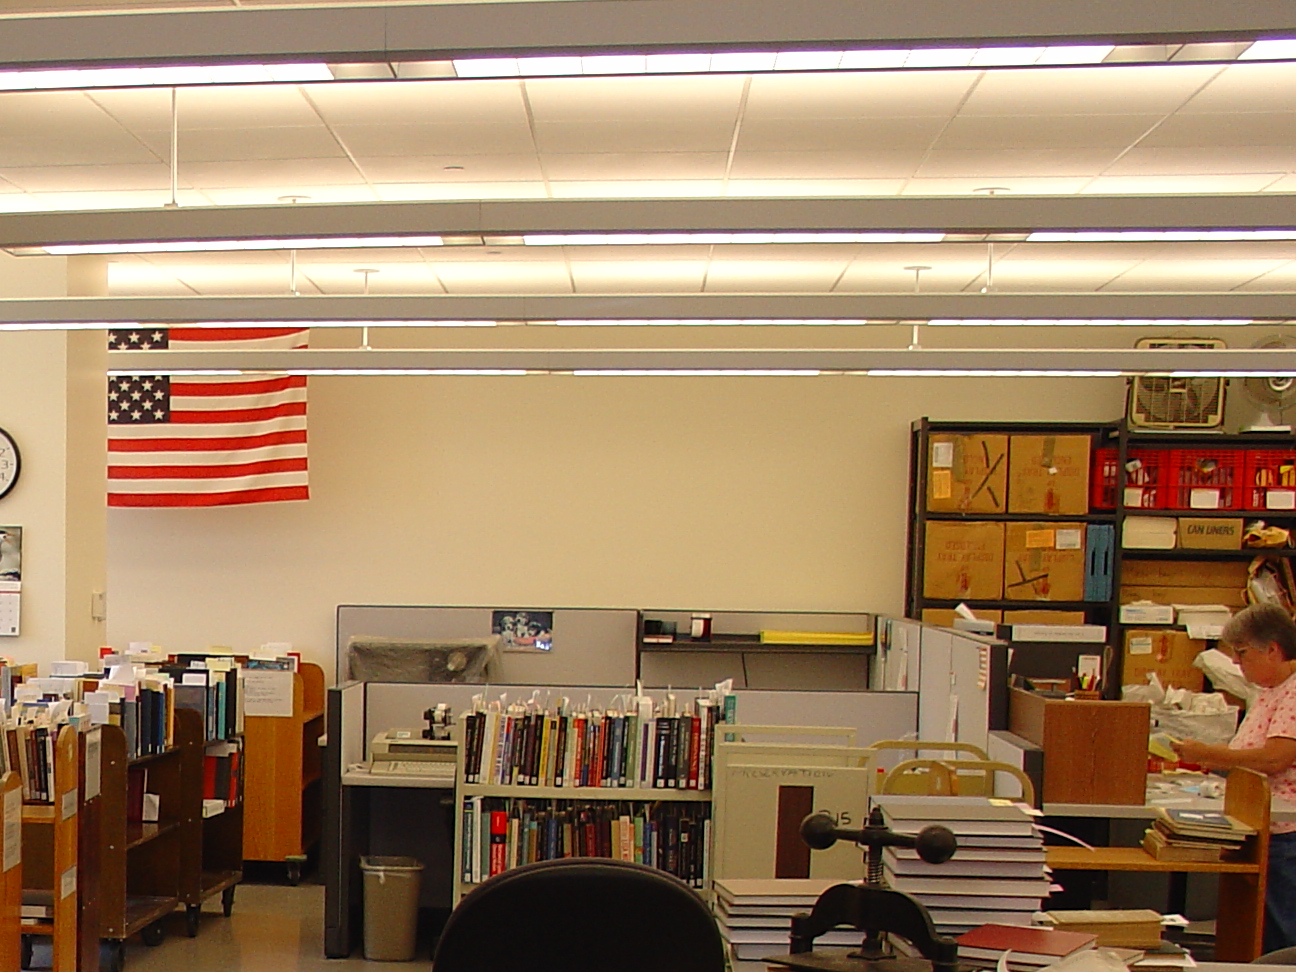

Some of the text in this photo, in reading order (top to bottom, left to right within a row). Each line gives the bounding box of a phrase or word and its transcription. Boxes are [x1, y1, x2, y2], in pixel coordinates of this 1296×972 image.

[1, 460, 8, 469] 3
[1187, 525, 1234, 535] CAN LINERS
